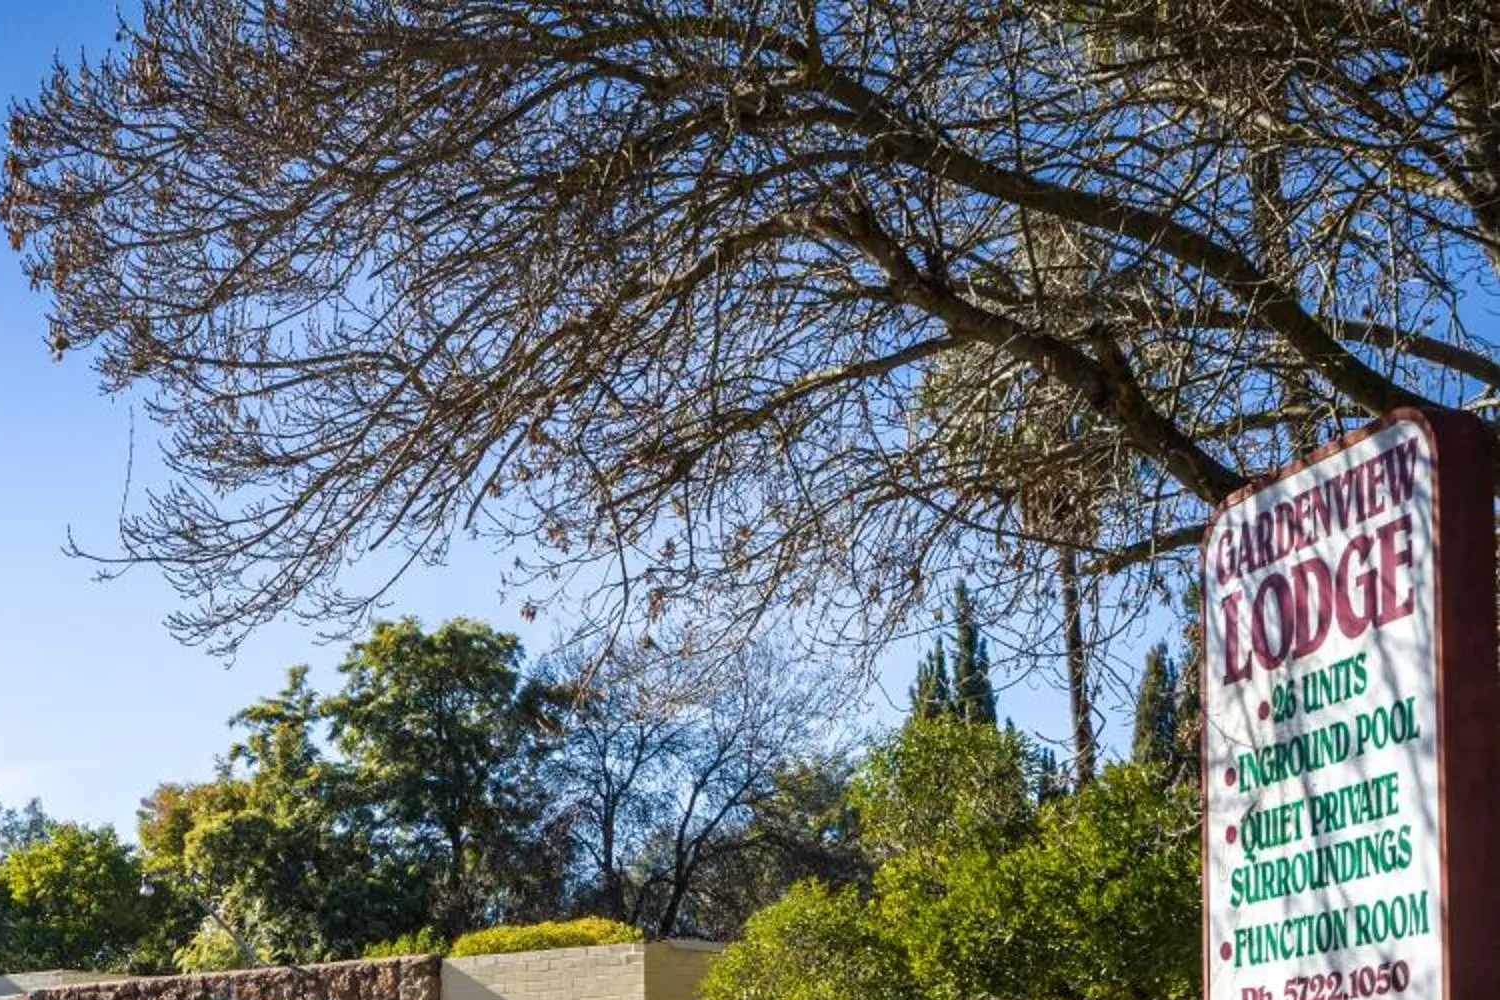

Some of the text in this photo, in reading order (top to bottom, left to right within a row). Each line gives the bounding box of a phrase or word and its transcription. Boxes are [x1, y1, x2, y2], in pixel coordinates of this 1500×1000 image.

[1215, 437, 1418, 585] GARDENVIEW
[1221, 514, 1415, 686] LODGE
[1272, 652, 1367, 723] 26 UNITS
[1237, 696, 1421, 793] INGROUND POOL
[1240, 772, 1399, 860] QUIET PRIVATE
[1230, 825, 1413, 908] SURROUNDINGS
[1233, 890, 1430, 968] FUNCTION ROOM
